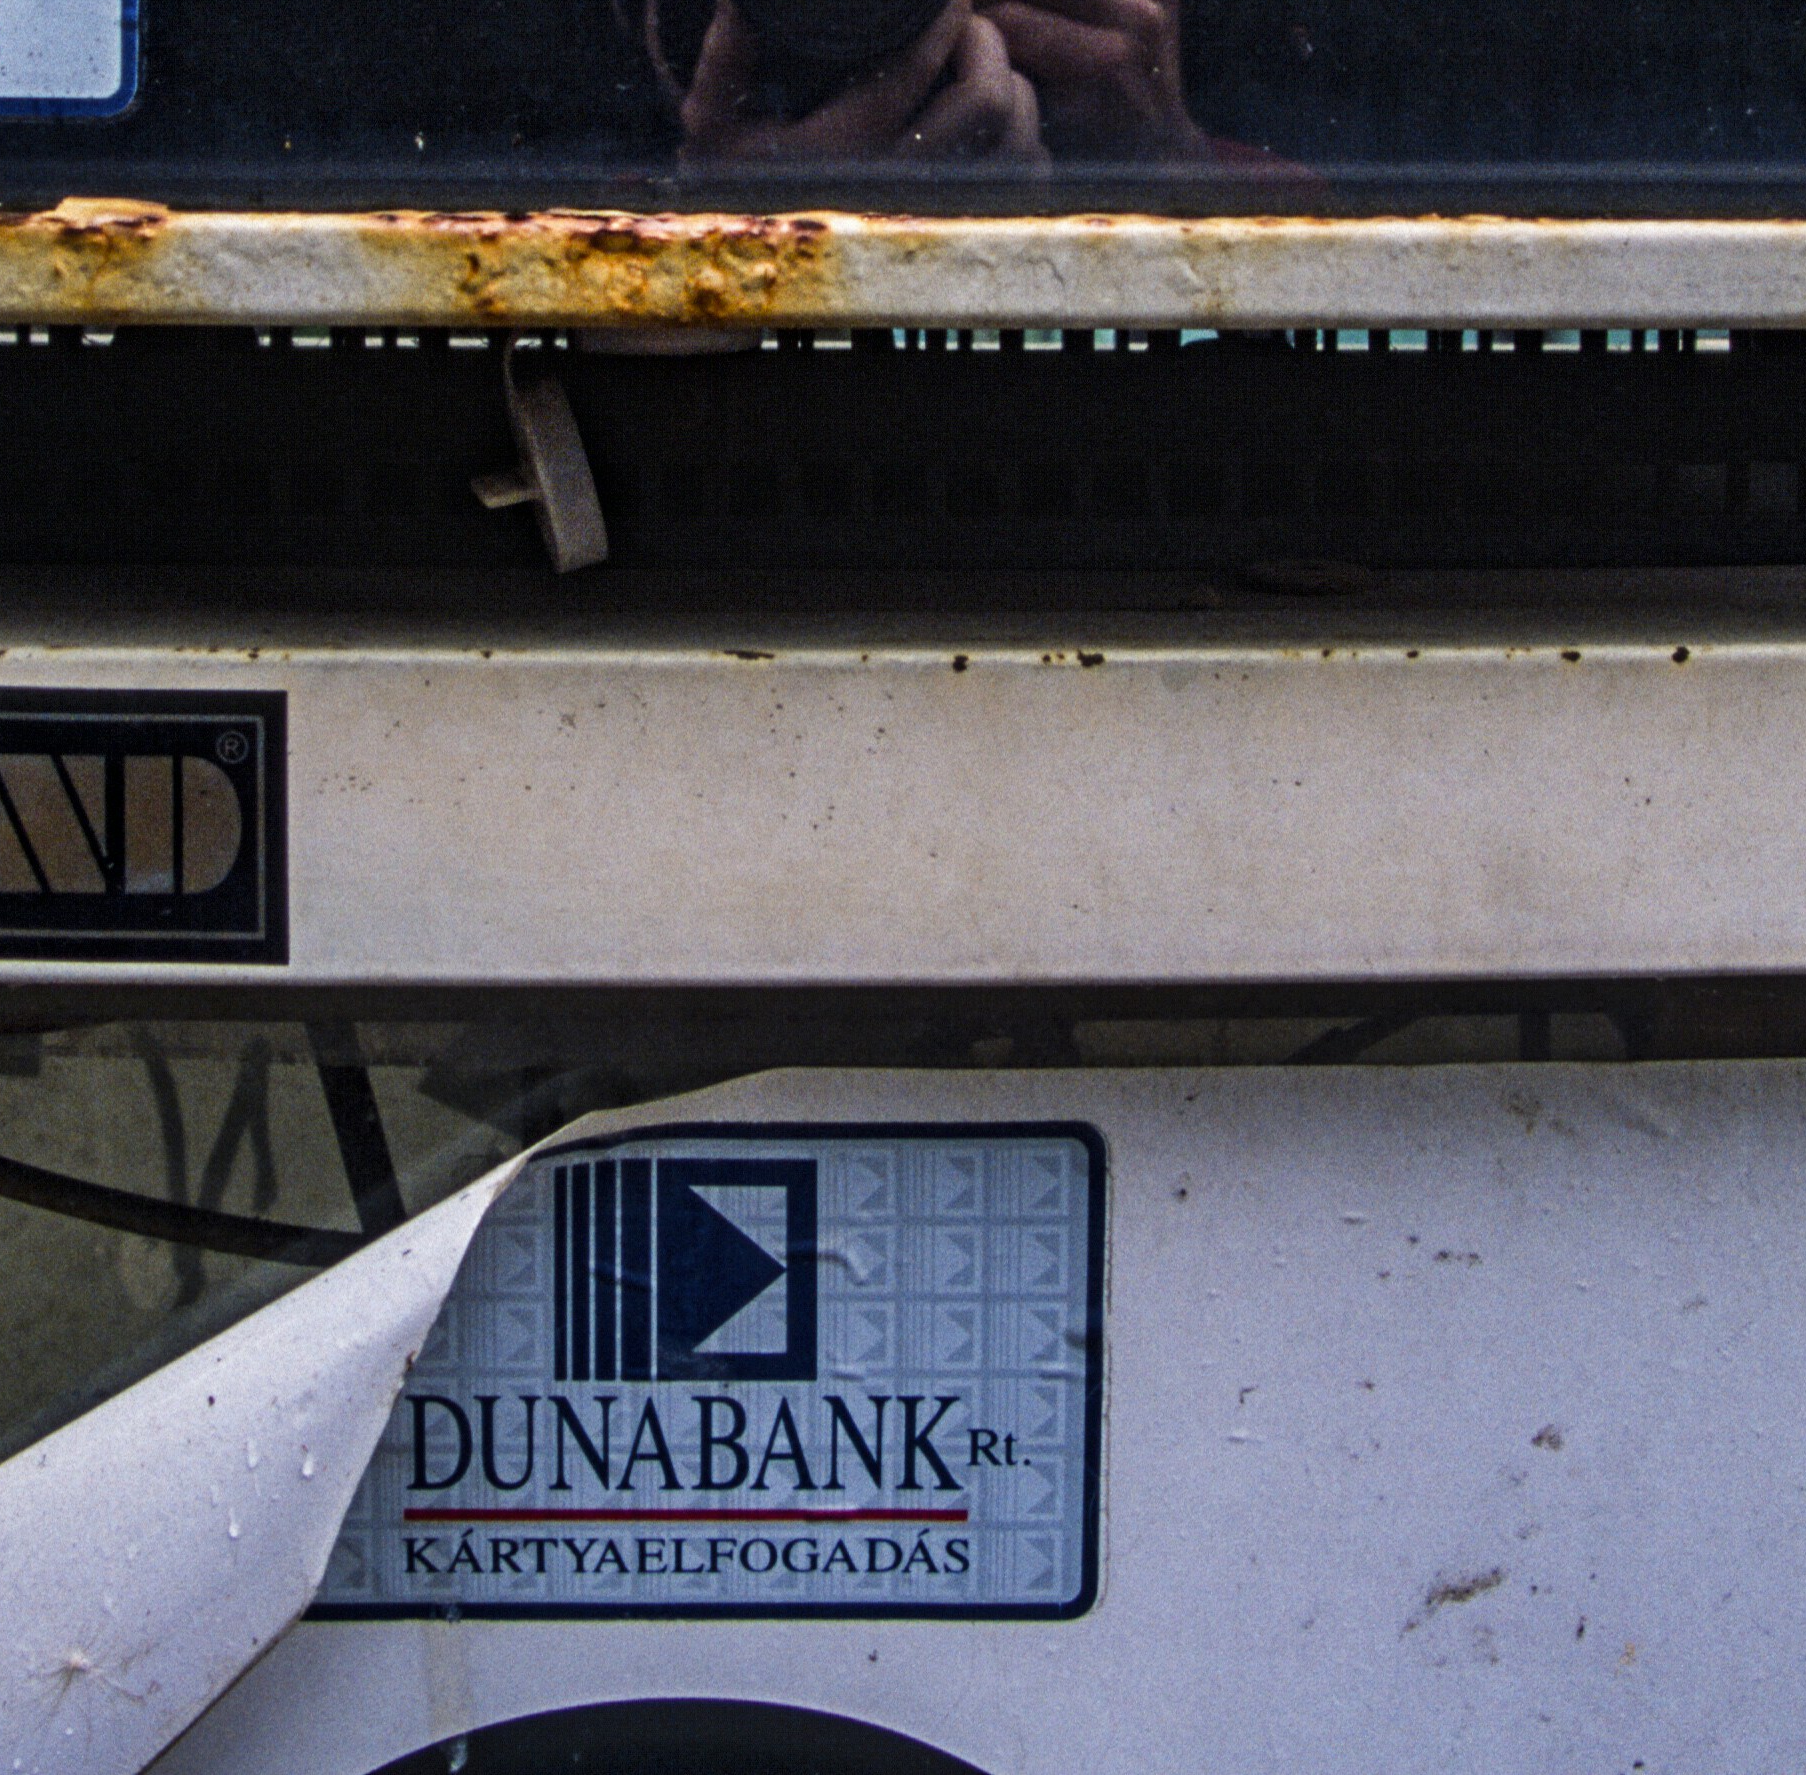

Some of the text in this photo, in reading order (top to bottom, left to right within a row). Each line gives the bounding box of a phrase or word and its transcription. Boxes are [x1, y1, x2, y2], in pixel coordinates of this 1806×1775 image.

[405, 1394, 1033, 1493] DUNABANK Rt.
[404, 1528, 972, 1574] KÁRTYAELFOGADÁS
